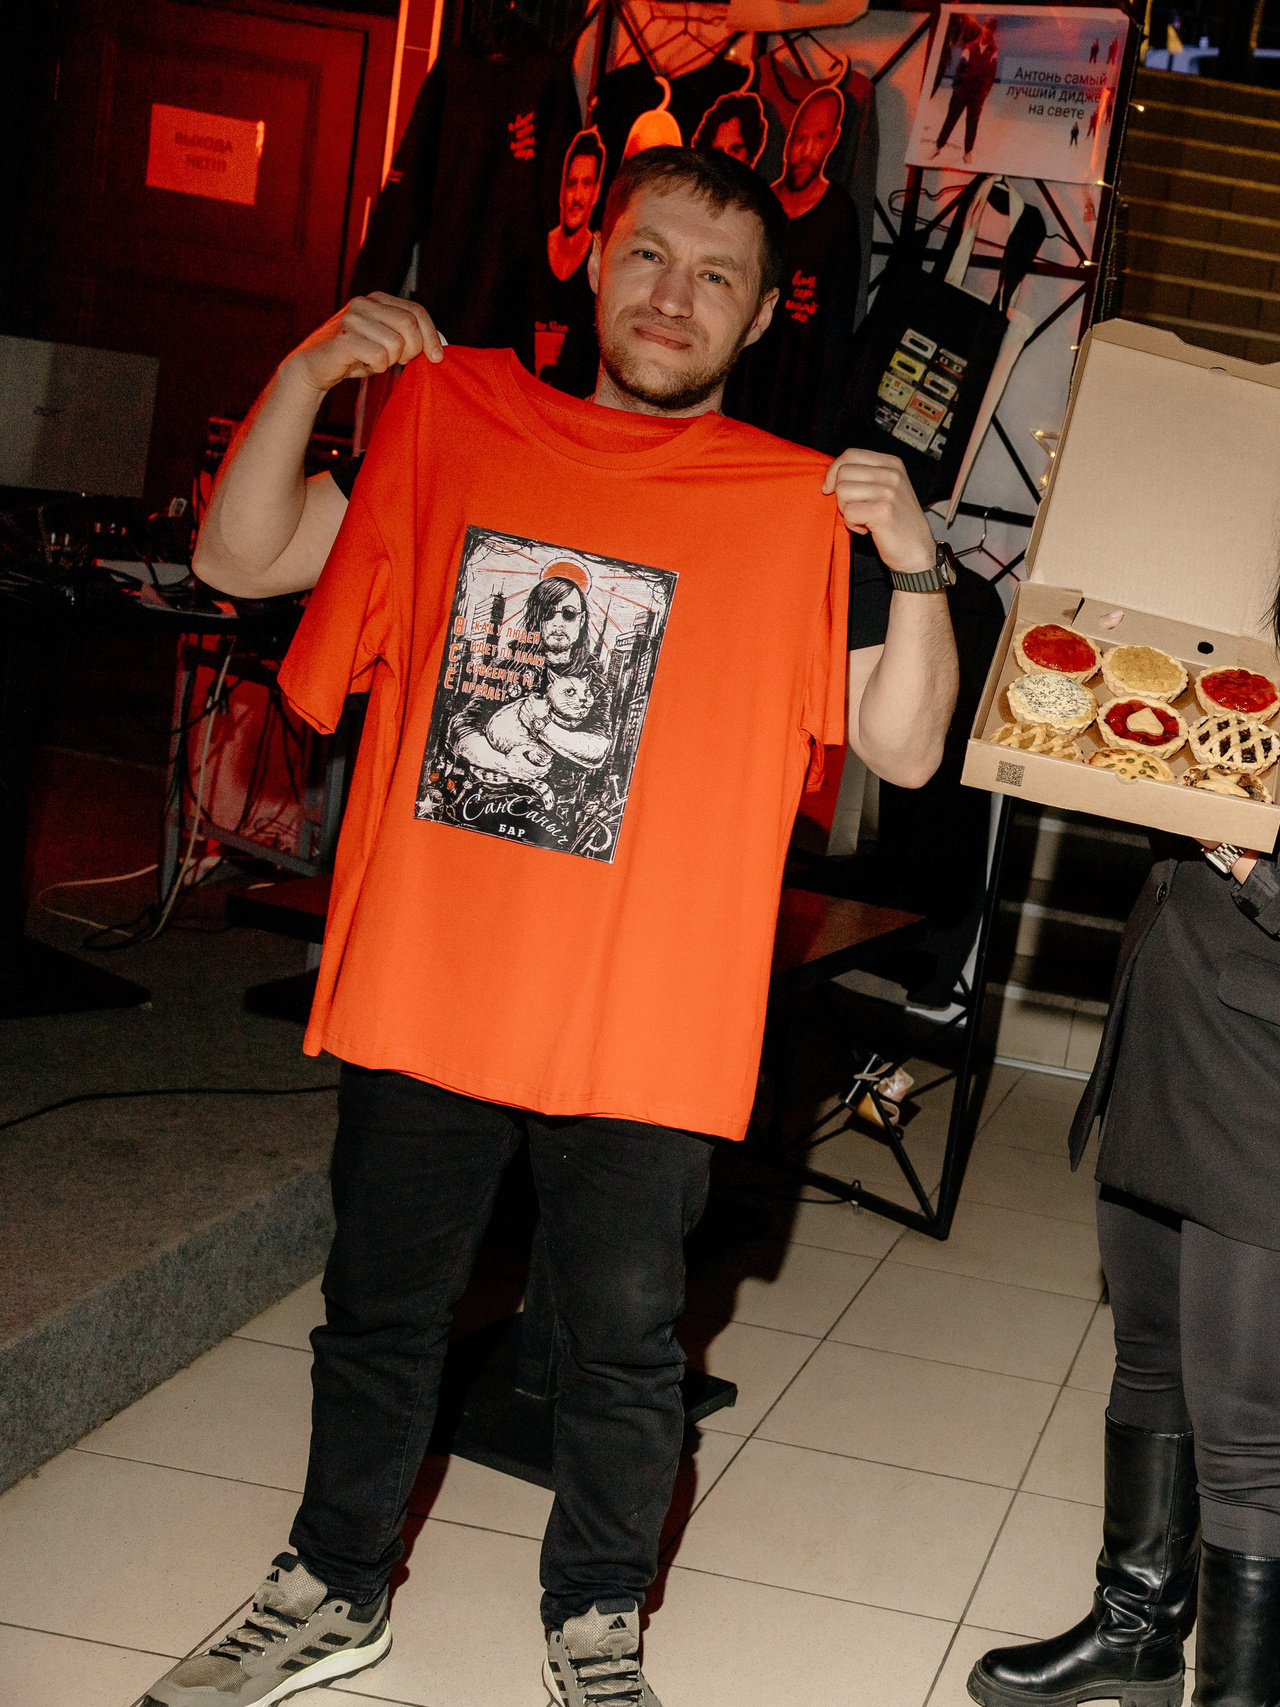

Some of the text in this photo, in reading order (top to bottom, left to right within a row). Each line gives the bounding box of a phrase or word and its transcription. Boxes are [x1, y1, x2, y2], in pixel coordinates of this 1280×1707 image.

[1014, 67, 1107, 86] Антонь самый
[1006, 85, 1101, 104] лучший дидже
[1028, 104, 1085, 119] на свете
[474, 621, 541, 645] КАК У ЛЮДЕЙ
[469, 641, 546, 668] ИДЕТ ПО ПЛАНУ
[466, 661, 534, 688] СОВСЕМ НЕ ТО
[498, 823, 526, 838] БАР
